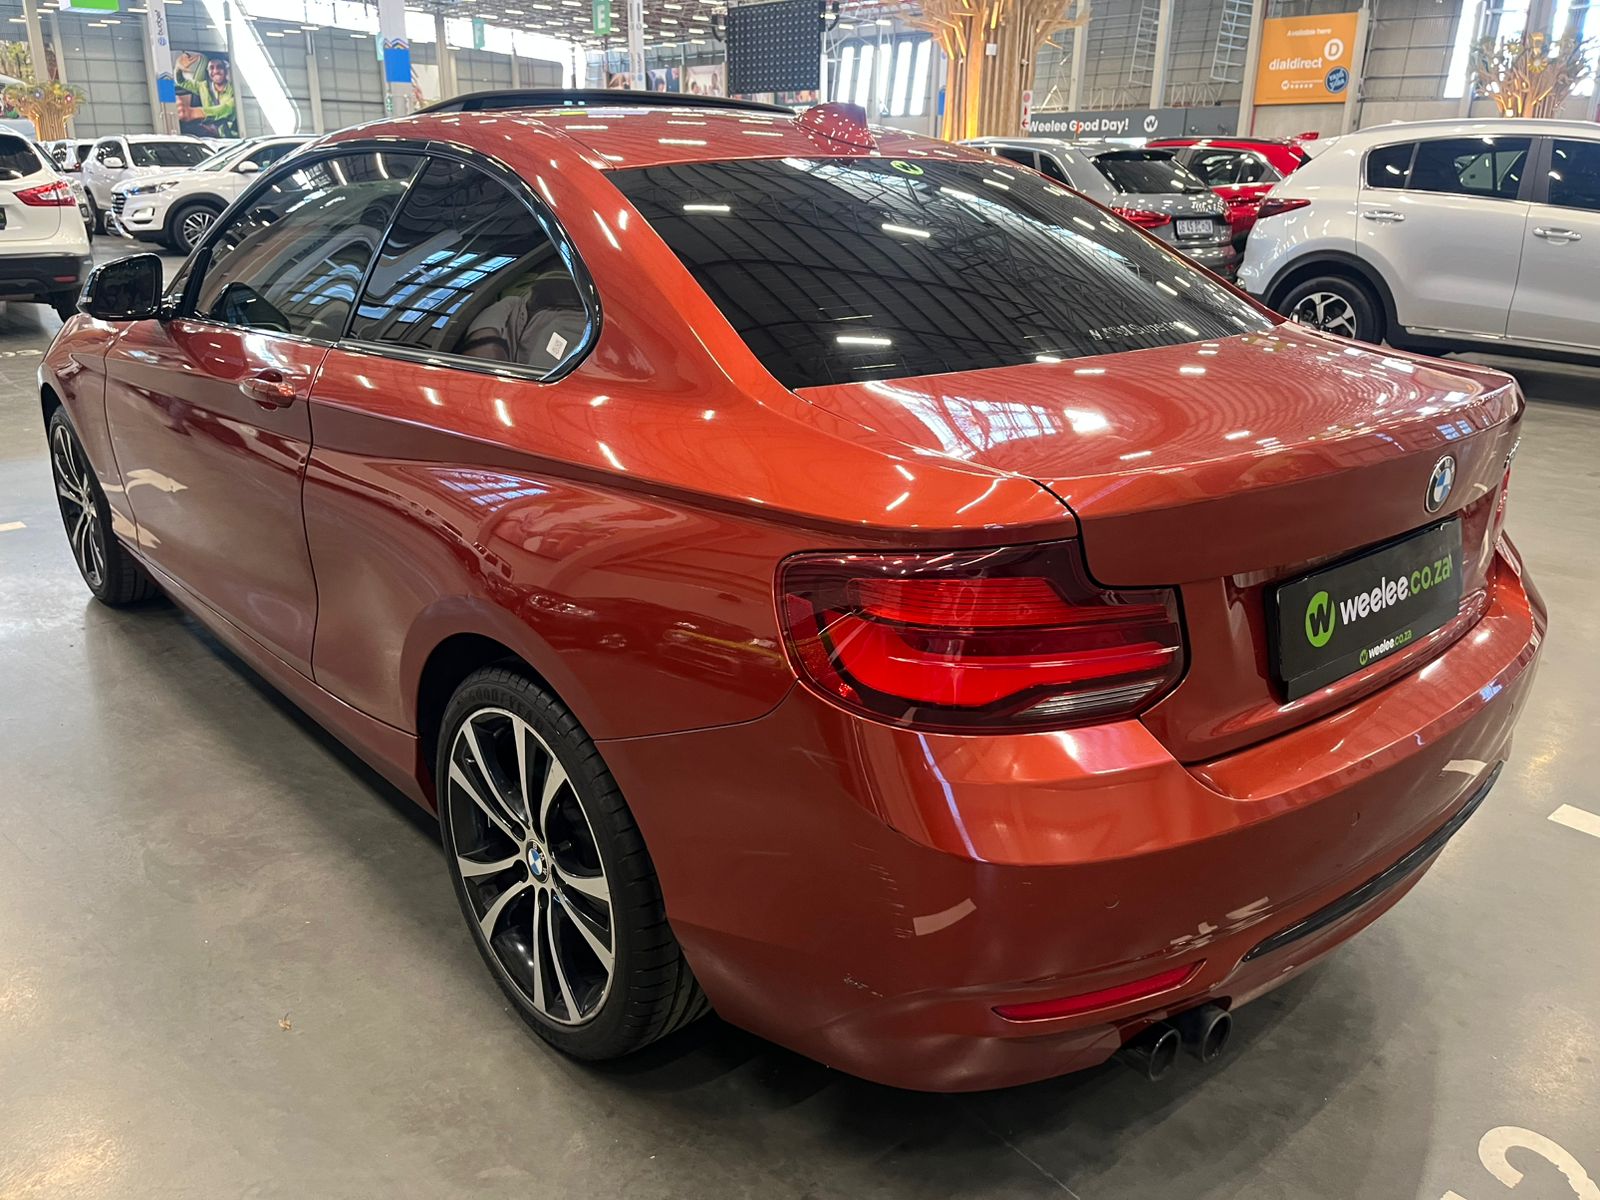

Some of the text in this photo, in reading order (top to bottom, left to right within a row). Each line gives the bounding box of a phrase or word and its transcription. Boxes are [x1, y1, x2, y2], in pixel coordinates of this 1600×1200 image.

[1268, 57, 1323, 71] dialdirect
[1029, 119, 1068, 133] Weelee
[1101, 118, 1129, 134] Day!
[1339, 557, 1452, 626] weelee.co.za
[1368, 629, 1412, 659] weelee.co.za
